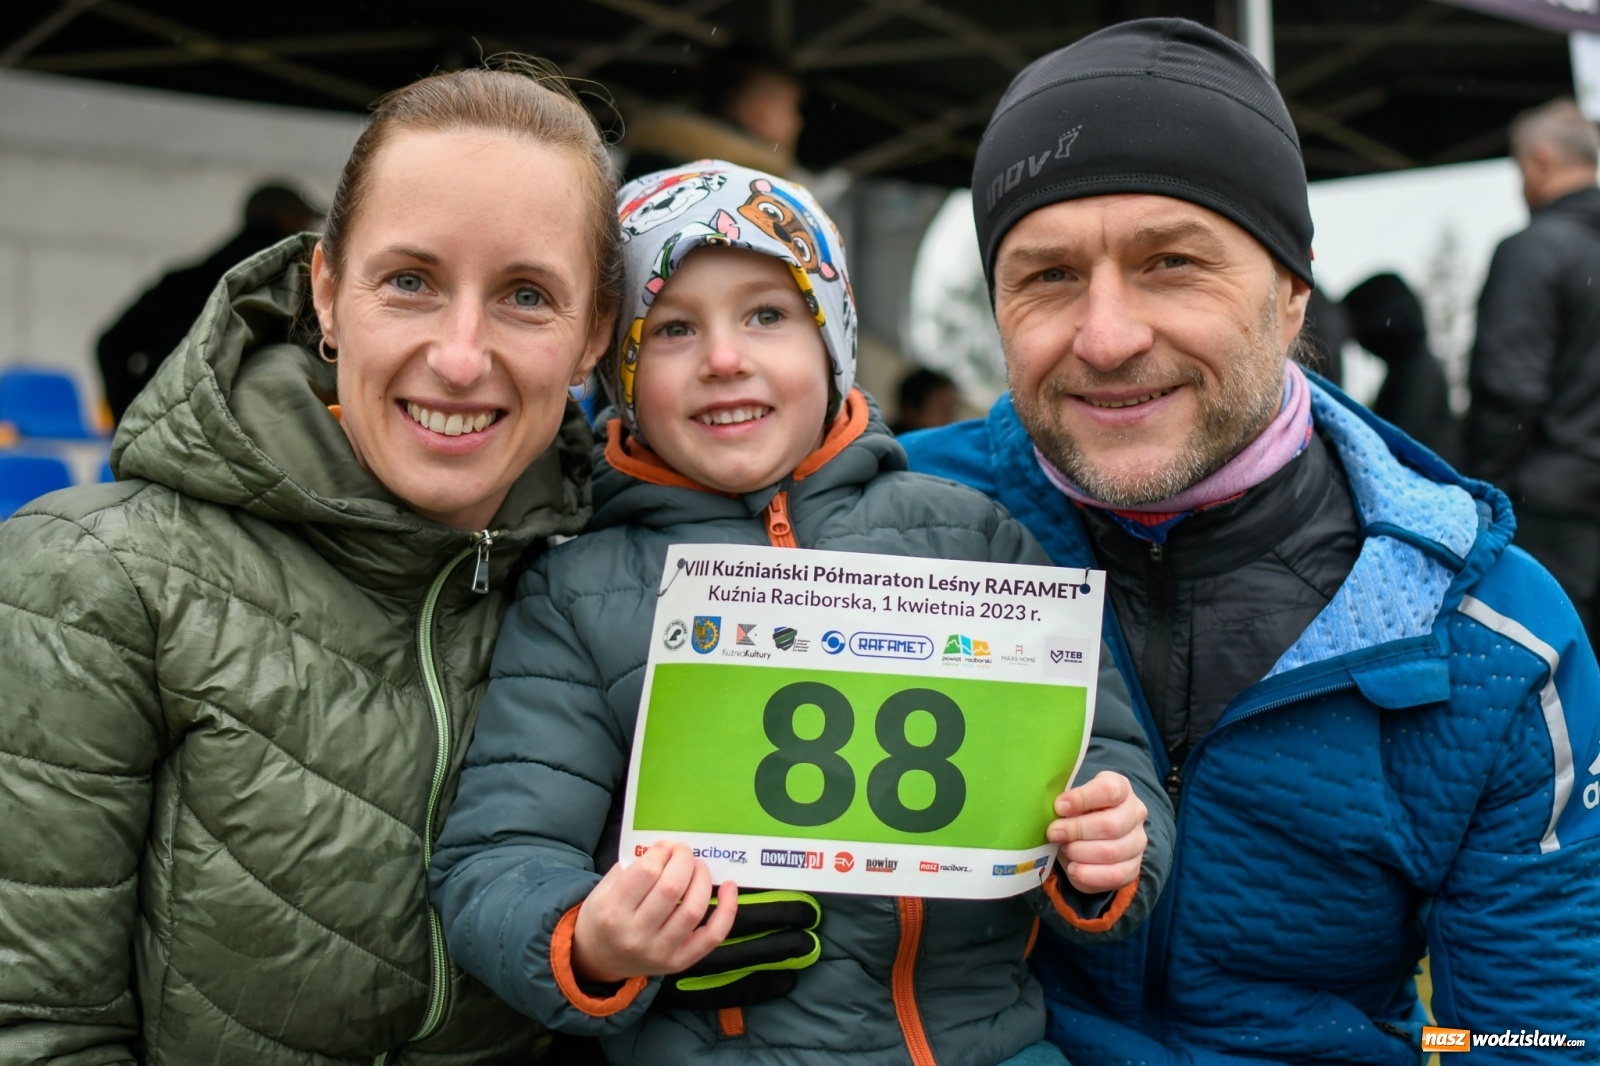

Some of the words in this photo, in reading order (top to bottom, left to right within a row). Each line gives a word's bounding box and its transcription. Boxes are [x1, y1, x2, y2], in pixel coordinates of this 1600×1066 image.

[713, 560, 809, 581] Kuźniański
[813, 566, 924, 589] Półmaraton
[929, 573, 981, 596] Leśny
[985, 578, 1081, 600] RAFAMET
[708, 585, 766, 603] Kuźnia
[771, 588, 877, 613] Raciborska,
[882, 596, 892, 611] 1
[897, 596, 975, 617] kwietnia
[979, 602, 1027, 621] 2023
[1030, 609, 1042, 622] r.
[858, 637, 928, 656] RAFAMET
[1064, 650, 1083, 659] TEB
[755, 682, 967, 834] 88
[693, 846, 747, 861] aciborz
[761, 850, 822, 869] nowiny.pl
[866, 857, 899, 871] nowiny
[920, 863, 938, 871] nasz
